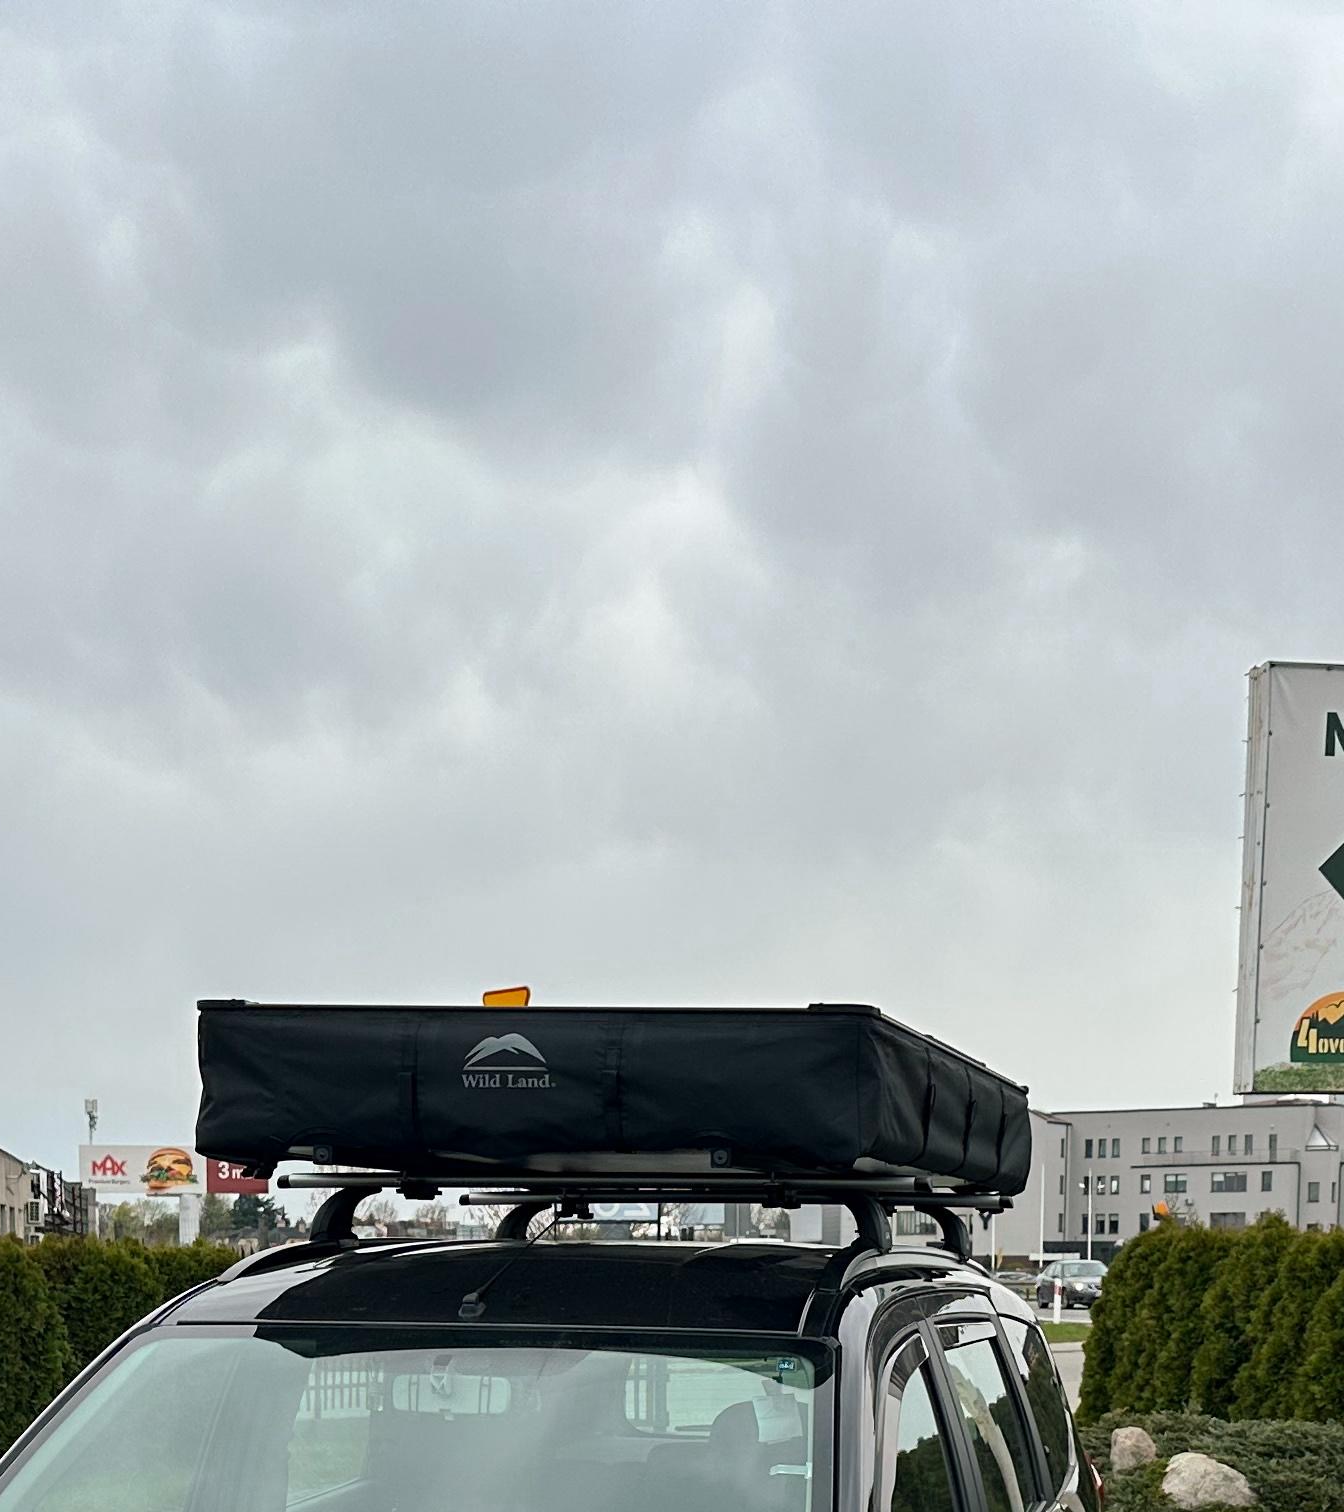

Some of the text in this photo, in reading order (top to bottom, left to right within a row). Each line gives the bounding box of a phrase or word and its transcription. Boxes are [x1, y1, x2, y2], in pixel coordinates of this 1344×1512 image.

[461, 1073, 501, 1089] Wild
[91, 1154, 127, 1176] MAX
[218, 1160, 230, 1180] 3
